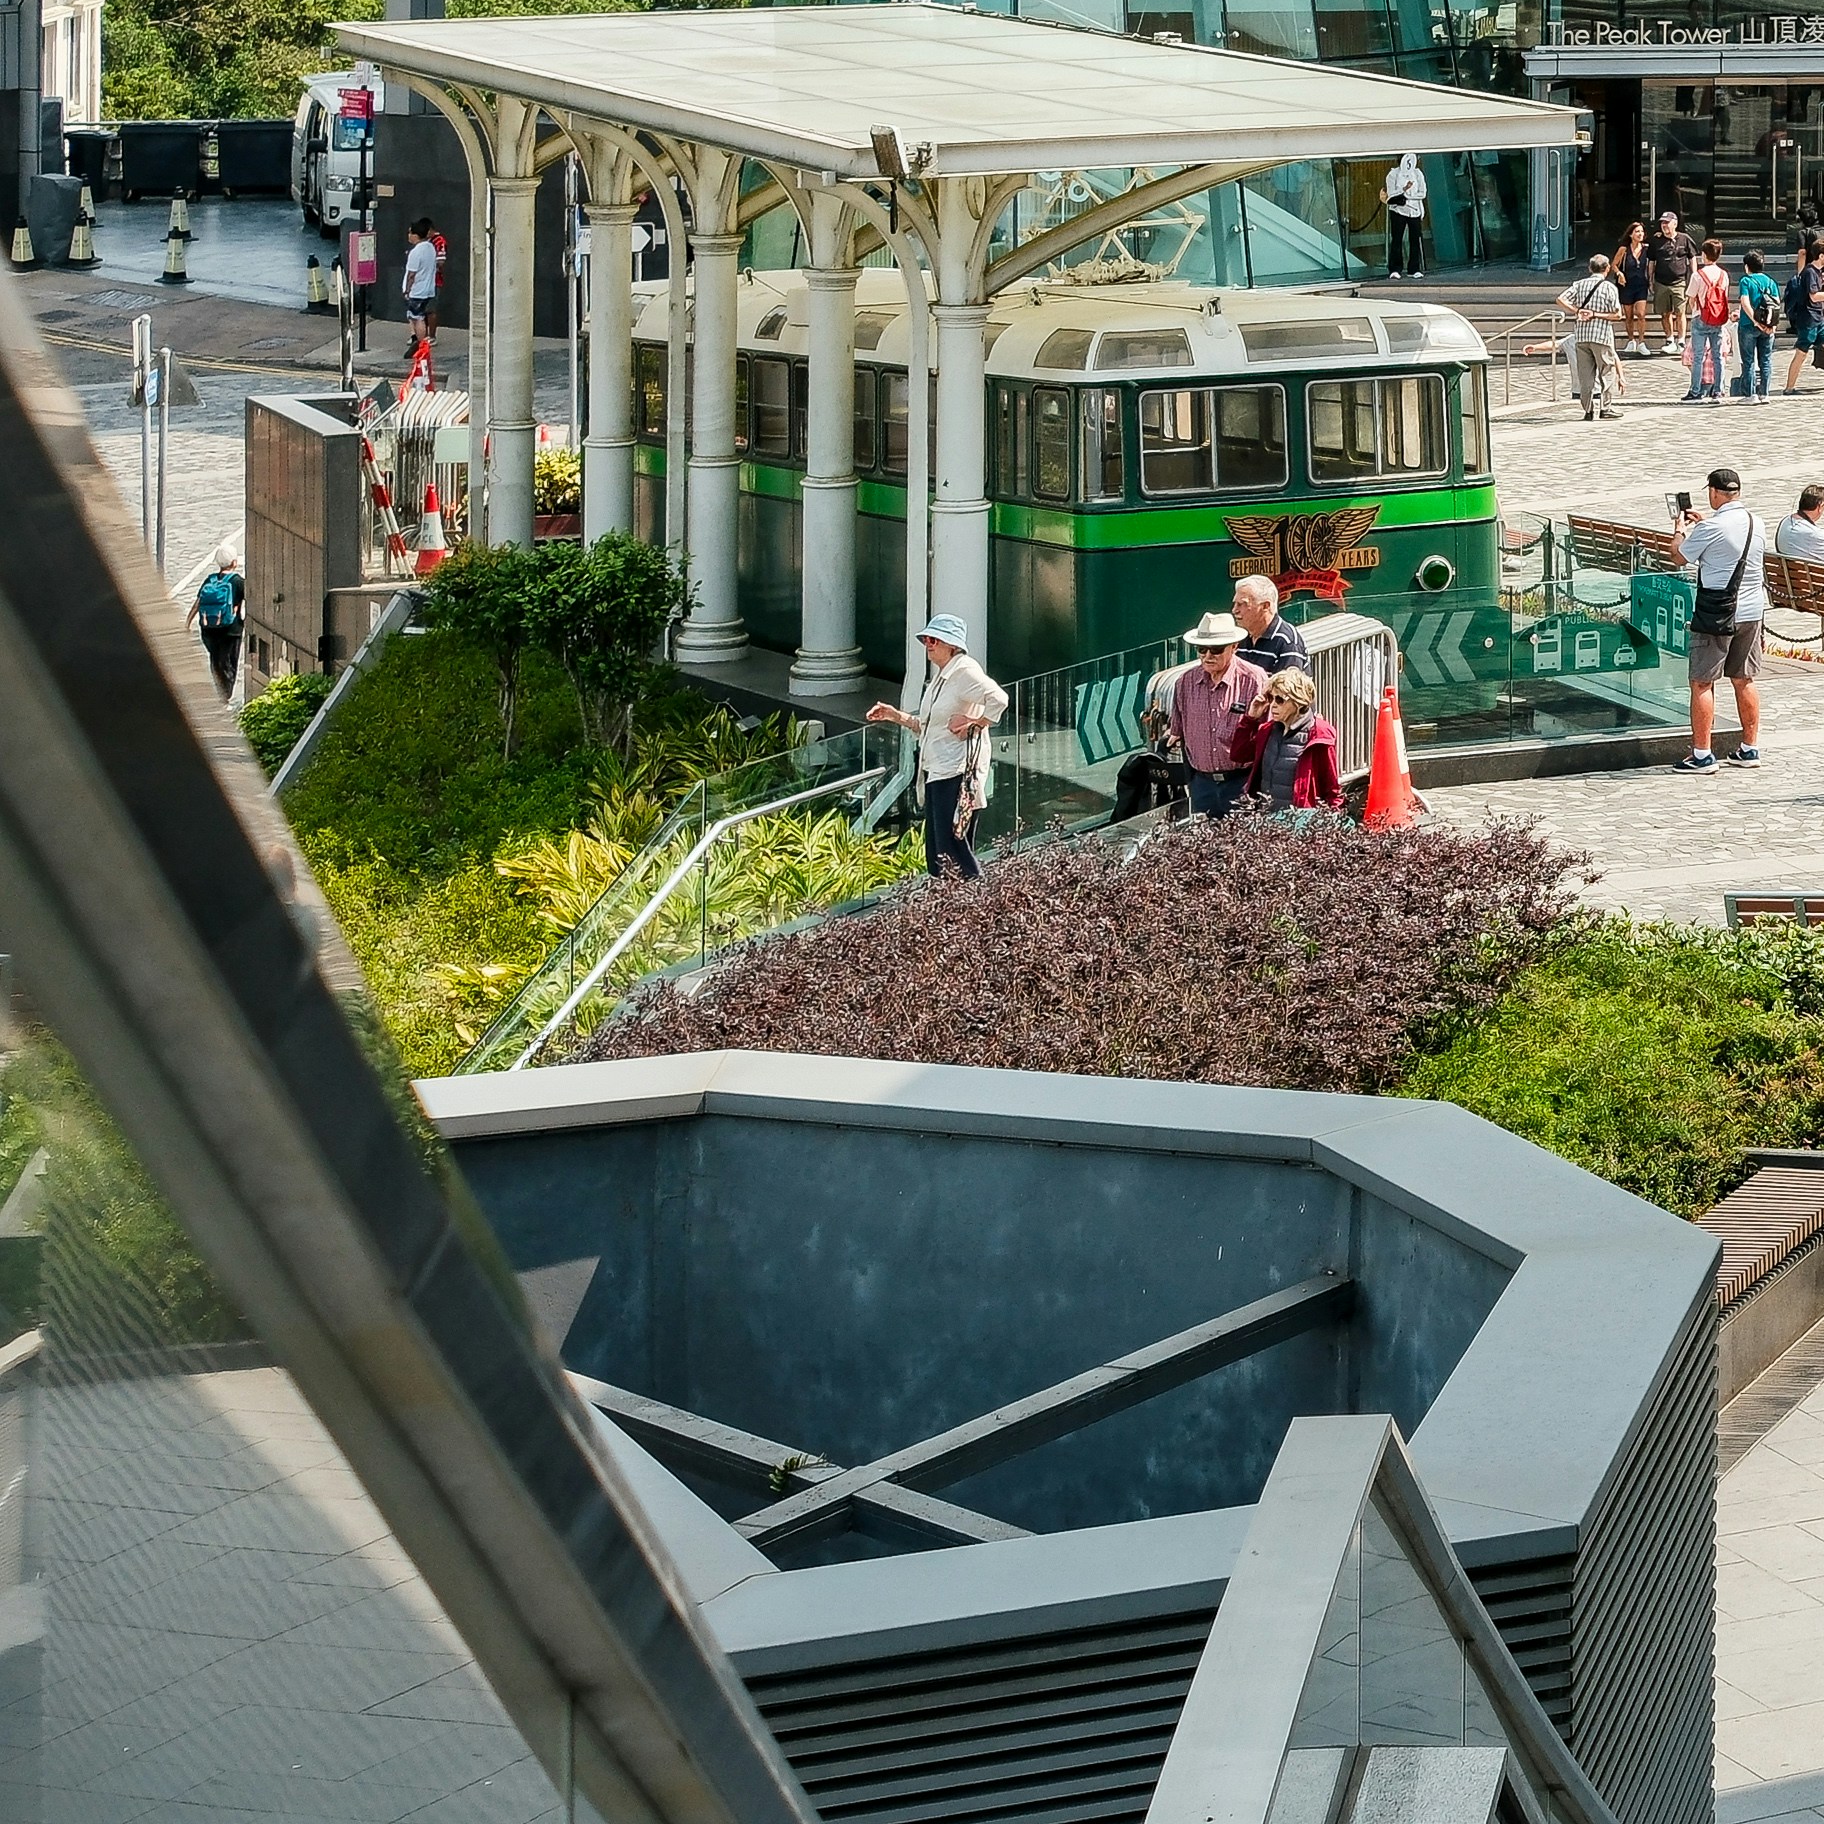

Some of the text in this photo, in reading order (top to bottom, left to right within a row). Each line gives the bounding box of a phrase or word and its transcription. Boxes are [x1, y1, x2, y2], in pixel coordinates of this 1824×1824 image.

[1546, 20, 1590, 46] The
[1596, 20, 1653, 46] Peak
[1657, 20, 1731, 46] Tower
[1230, 557, 1275, 576] CELEBRATE
[1341, 548, 1377, 568] YEARS
